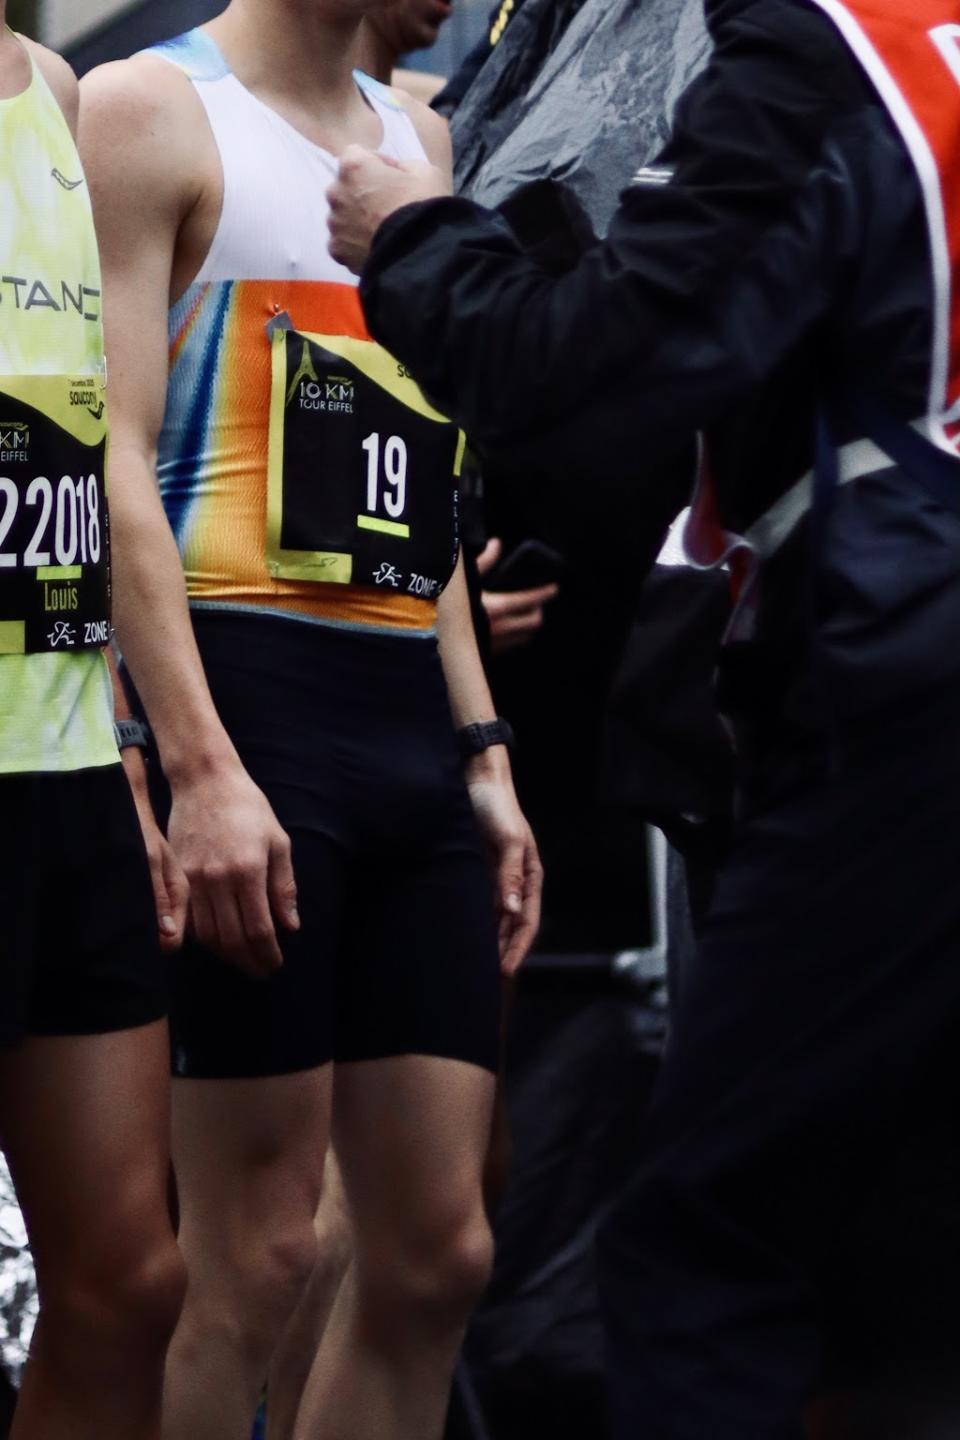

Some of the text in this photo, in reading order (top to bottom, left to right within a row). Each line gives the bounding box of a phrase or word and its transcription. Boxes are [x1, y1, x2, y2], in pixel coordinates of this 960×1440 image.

[300, 381, 355, 401] 10 KM
[299, 398, 354, 414] TOUR EIFFEL
[1, 450, 29, 462] EIFFEL
[361, 431, 408, 518] 19
[44, 580, 79, 612] Louis
[84, 620, 108, 645] ZONE
